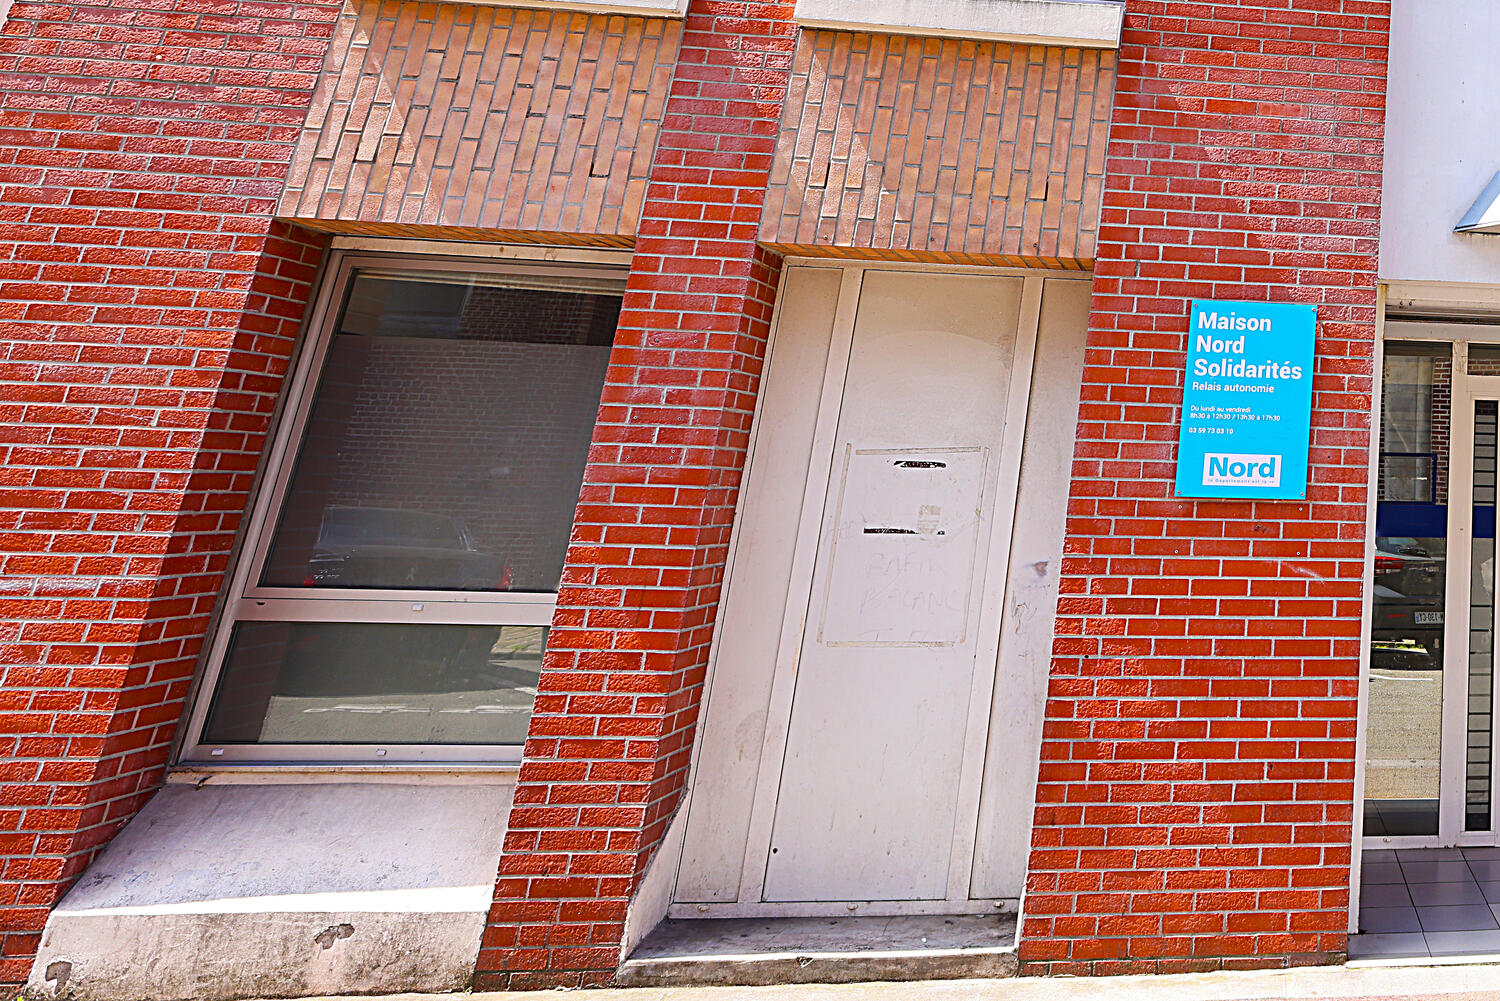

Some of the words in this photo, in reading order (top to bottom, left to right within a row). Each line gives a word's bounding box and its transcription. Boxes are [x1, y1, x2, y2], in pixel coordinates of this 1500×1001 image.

[1198, 311, 1272, 332] Maison
[1196, 334, 1245, 354] Nord
[1193, 358, 1302, 379] Solidarités
[1192, 381, 1222, 391] Relais
[1223, 383, 1275, 393] autonomie
[1208, 456, 1276, 478] Nord
